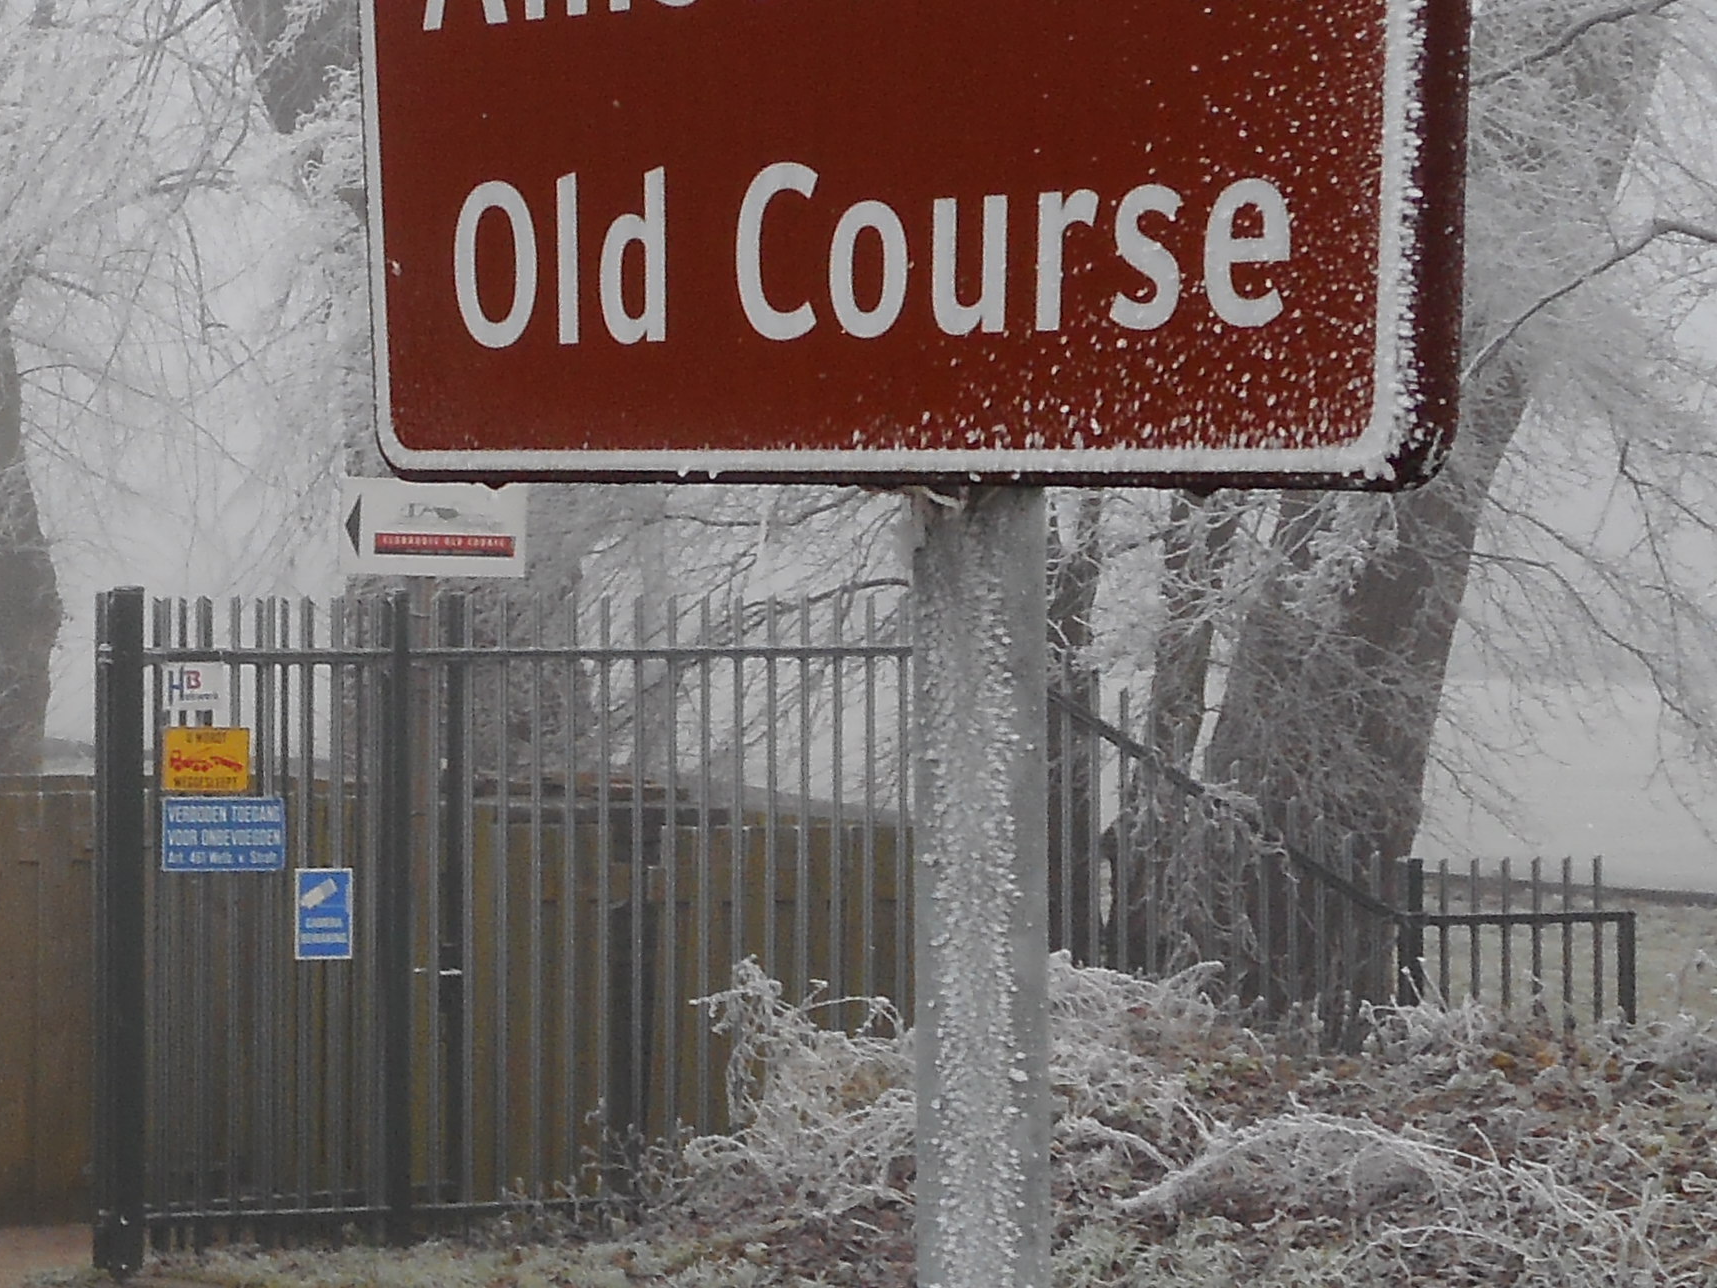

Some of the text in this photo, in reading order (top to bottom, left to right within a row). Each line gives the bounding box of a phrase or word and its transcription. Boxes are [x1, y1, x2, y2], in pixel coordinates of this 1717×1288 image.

[453, 162, 1292, 350] Old Course
[167, 805, 281, 823] VERBODEN TOEGANG
[167, 829, 198, 846] VOOR
